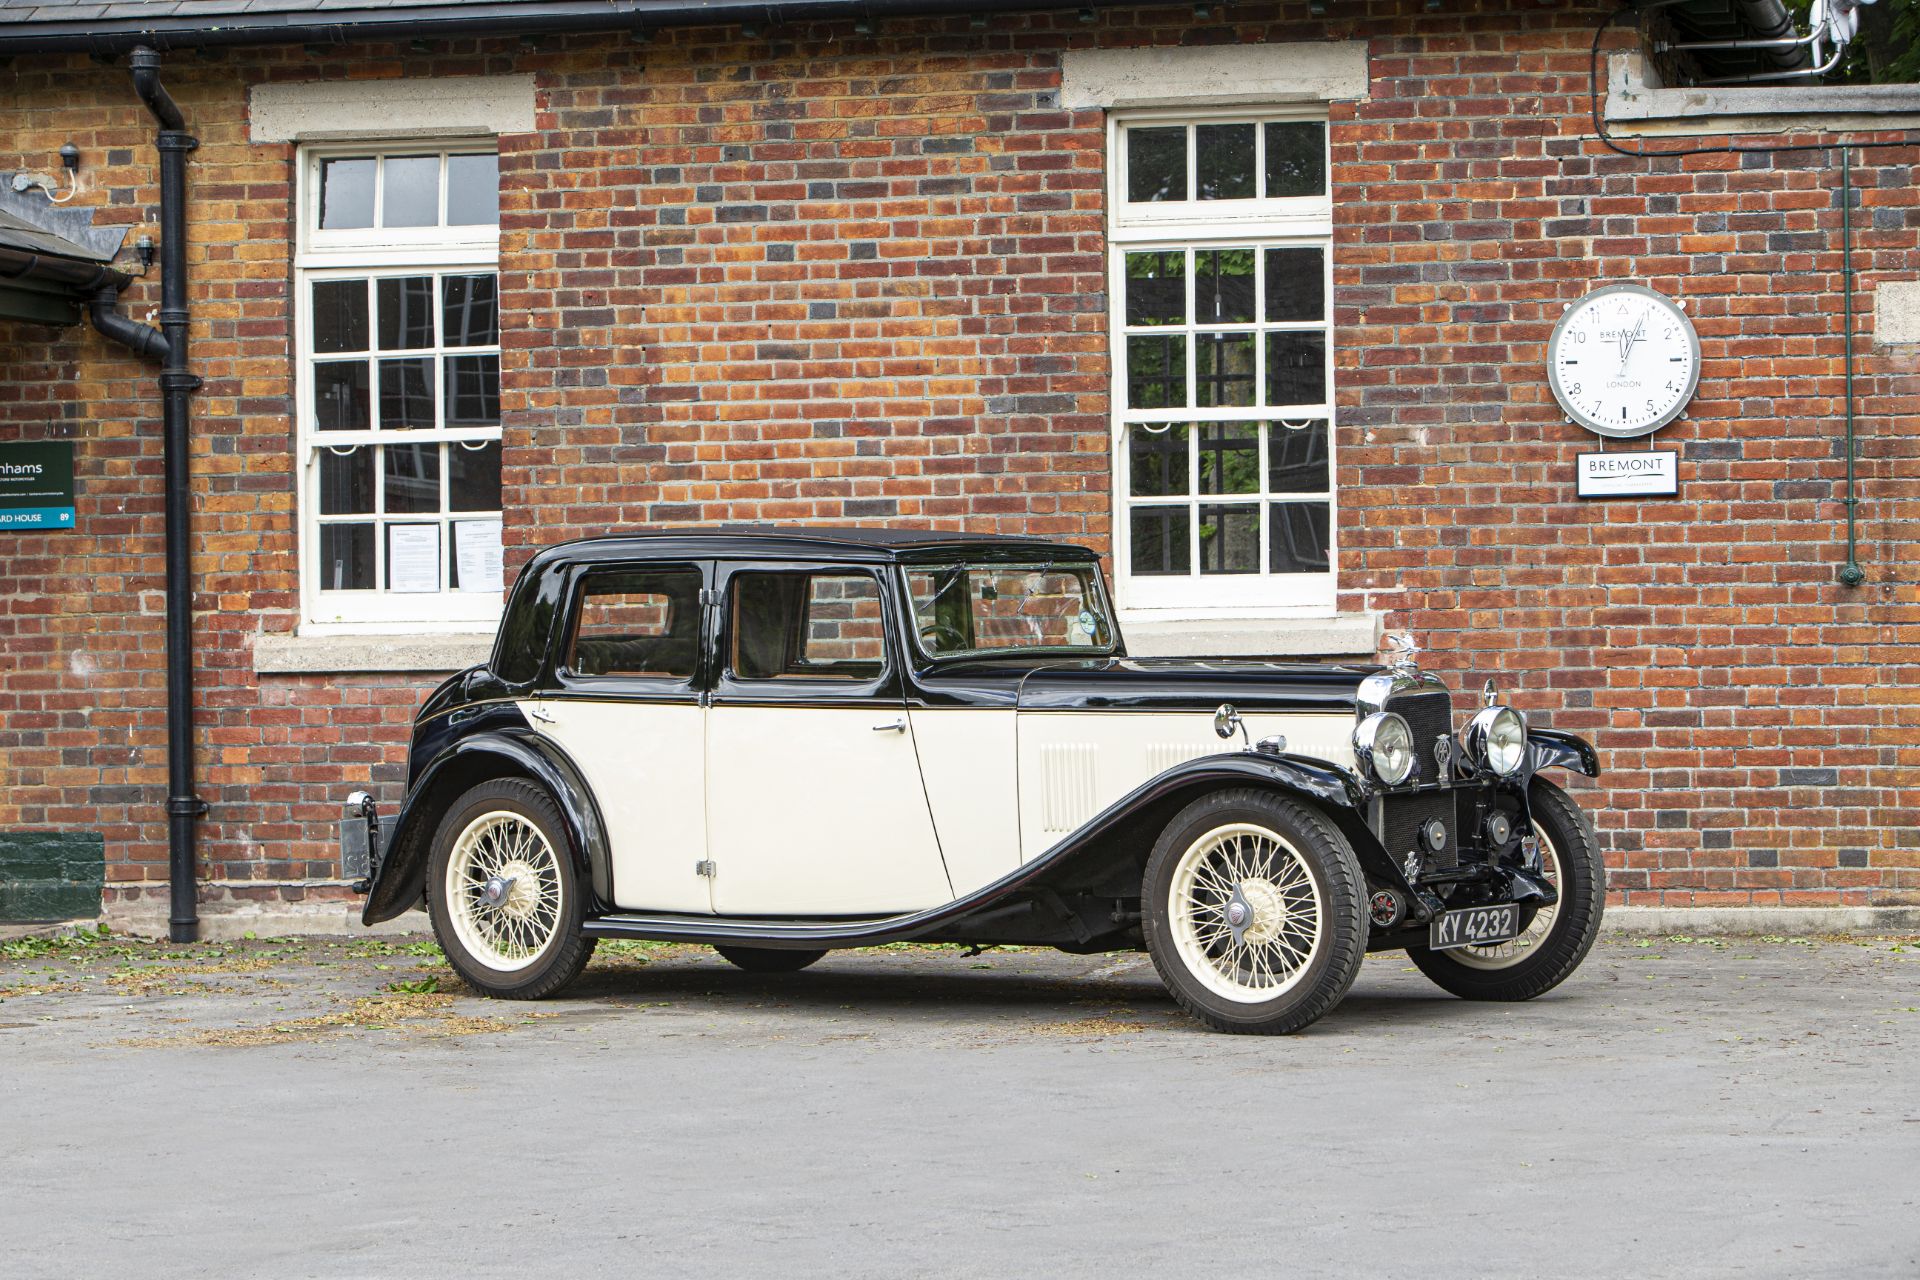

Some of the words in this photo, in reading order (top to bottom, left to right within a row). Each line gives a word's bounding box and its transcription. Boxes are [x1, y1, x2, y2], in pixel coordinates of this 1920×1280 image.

[1591, 312, 1600, 324] 11
[1573, 332, 1586, 343] 10
[1663, 327, 1672, 340] 2
[1573, 383, 1582, 395] 8
[1665, 380, 1673, 391] 4
[1594, 400, 1602, 412] 7
[1646, 400, 1654, 411] 5
[1589, 458, 1664, 472] BREMONT
[14, 513, 42, 522] HOUSE
[60, 513, 70, 521] 89
[1438, 913, 1461, 944] KY
[1465, 908, 1511, 939] 4232
